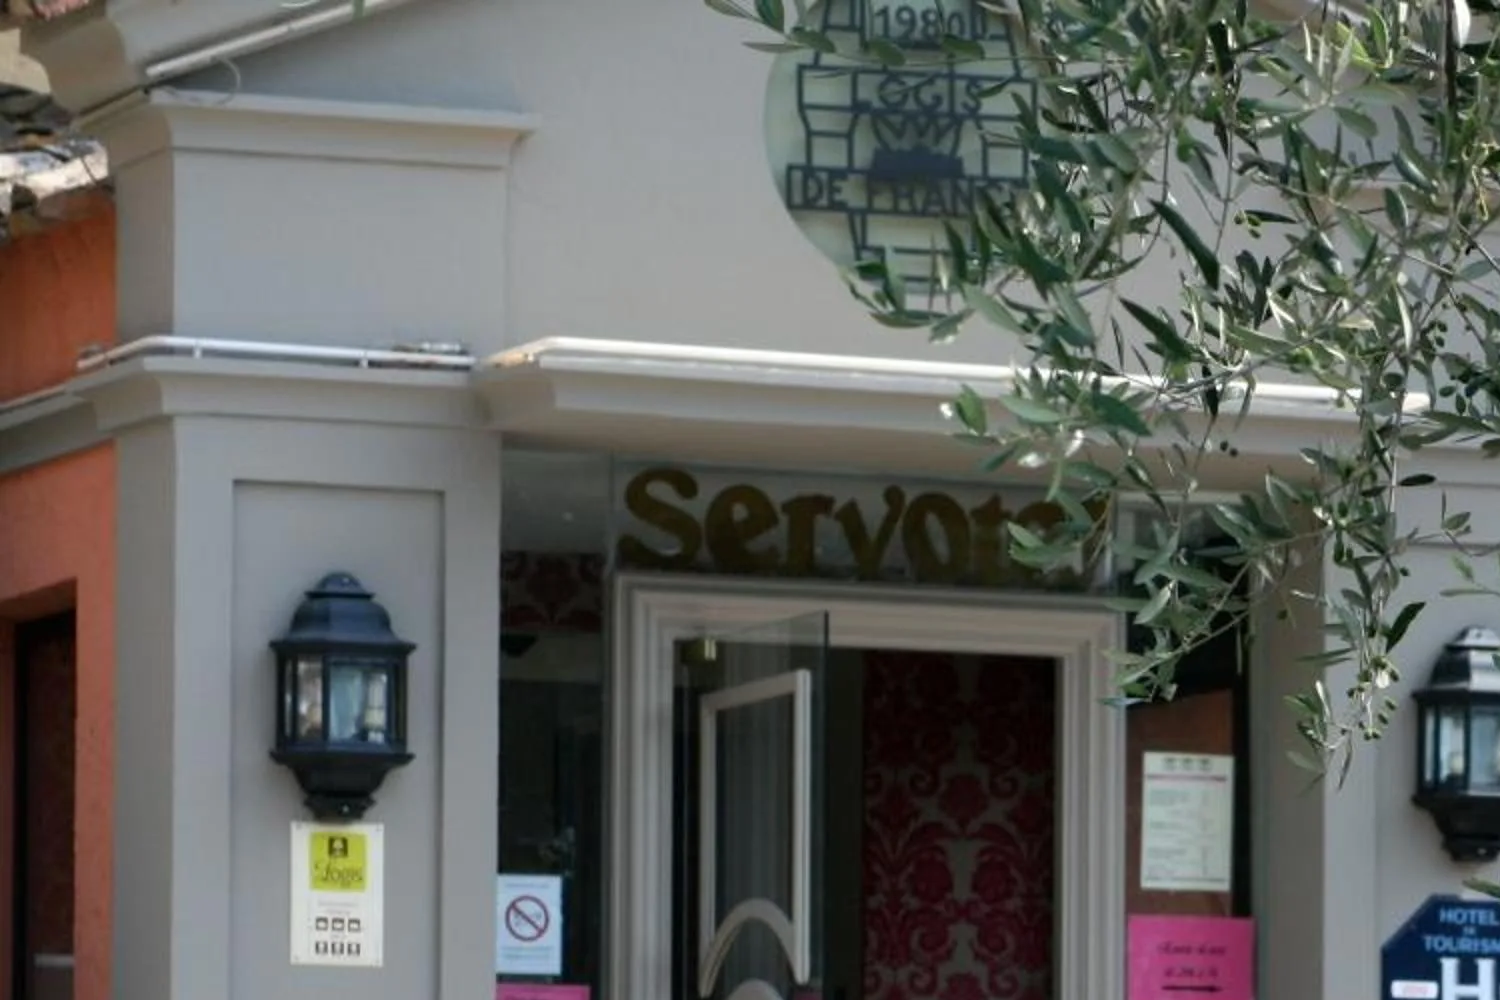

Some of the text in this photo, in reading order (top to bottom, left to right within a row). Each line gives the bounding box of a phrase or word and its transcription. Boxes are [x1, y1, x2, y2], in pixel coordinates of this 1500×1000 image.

[804, 169, 1024, 218] DE FRAN
[1439, 908, 1500, 926] HOTEL
